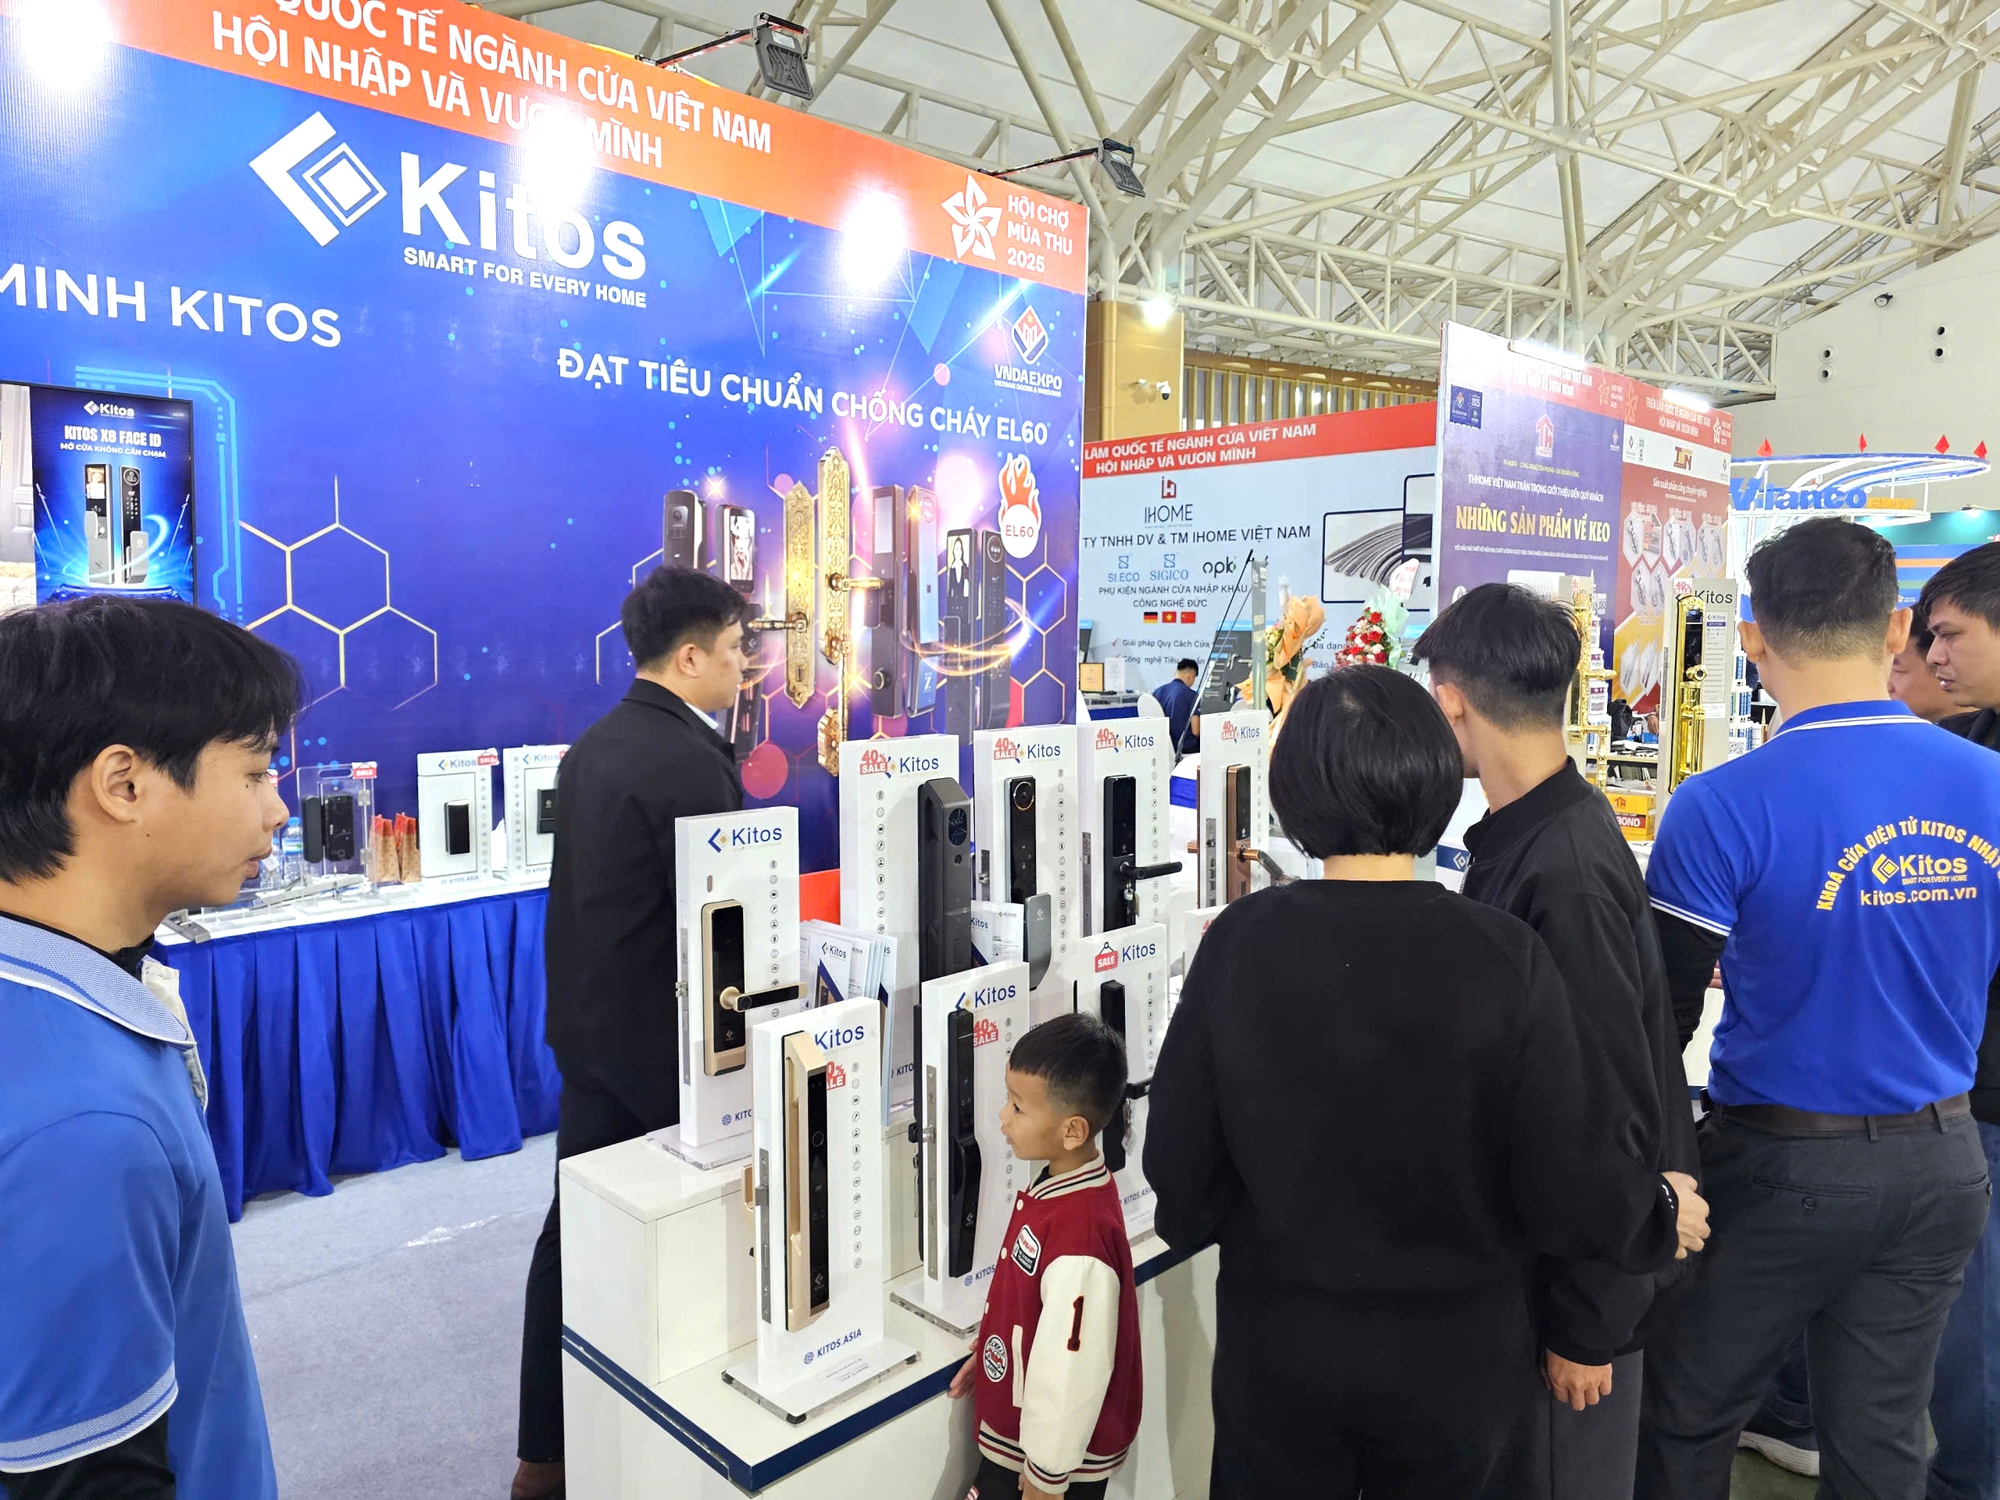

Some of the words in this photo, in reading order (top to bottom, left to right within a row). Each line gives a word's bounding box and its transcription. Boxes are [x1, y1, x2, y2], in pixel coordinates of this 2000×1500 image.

[213, 11, 289, 67] HỘI
[304, 37, 411, 96] NHẬP
[421, 70, 471, 117] VÀ
[585, 116, 662, 168] MÌNH
[396, 9, 443, 54] TẾ
[449, 23, 567, 92] NGÀNH
[577, 64, 638, 114] CỬA
[646, 86, 704, 132] VIỆT
[712, 106, 771, 153] NAM
[400, 151, 647, 281] Kitos
[1008, 194, 1035, 220] HỘI
[1037, 204, 1069, 232] CHỢ
[1007, 220, 1041, 247] MÙA
[1043, 232, 1073, 256] THU
[1007, 247, 1045, 273] 2025
[403, 246, 477, 276] SMART
[483, 263, 523, 285] FOR
[529, 271, 590, 297] EVERY
[595, 284, 647, 308] HOME
[170, 286, 342, 348] KITOS
[994, 363, 1062, 391] VNDAEXPO
[557, 348, 630, 390] ĐẠT
[638, 358, 711, 397] TIÊU
[720, 371, 823, 415] CHUẨN
[831, 387, 923, 428] CHỐNG
[930, 405, 991, 437] CHÁY
[997, 416, 1048, 445] EL60
[100, 403, 135, 417] Kitos
[64, 425, 98, 442] KITOS
[119, 430, 147, 446] FACE
[149, 433, 162, 448] ID
[1111, 440, 1147, 457] QUỐC
[1150, 437, 1166, 453] TẾ
[1167, 433, 1213, 451] NGÀNH
[1249, 426, 1279, 443] VIỆT
[1283, 423, 1316, 439] NAM
[1096, 459, 1117, 475] HỘI
[1120, 456, 1154, 473] NHẬP
[1157, 453, 1175, 468] VÀ
[1220, 445, 1256, 463] MÌNH
[1144, 503, 1194, 524] IHOME
[1455, 502, 1507, 533] NHỮNG
[1510, 505, 1536, 536] SẢN
[1538, 508, 1572, 540] PHẨM
[1588, 520, 1611, 543] KEO
[1005, 524, 1034, 538] EL60
[1083, 537, 1097, 548] TY
[1101, 535, 1133, 547] TNHH
[1137, 533, 1154, 546] DV
[1157, 533, 1166, 545] &
[1170, 531, 1188, 544] TM
[1192, 529, 1236, 543] IHOME
[1241, 525, 1273, 543] VIỆT
[1277, 525, 1311, 539] NAM
[1149, 569, 1189, 581] SIGICO
[1133, 599, 1156, 608] CÔNG
[1694, 590, 1733, 604] Kitos
[995, 737, 1016, 751] 40%
[1097, 739, 1115, 749] SALE
[1125, 735, 1155, 749] Kitos
[1241, 727, 1260, 740] Kitos
[861, 749, 887, 764] 40%
[995, 749, 1016, 760] SALE
[1027, 743, 1061, 759] Kitos
[450, 757, 477, 769] Kitos
[861, 762, 886, 774] SALE
[900, 757, 939, 773] Kitos
[732, 826, 783, 847] Kitos
[1816, 870, 1847, 911] KHOÁ
[1838, 843, 1869, 872] CỬA
[1864, 824, 1898, 850] ĐIỆN
[1921, 820, 1967, 844] KITOS
[1899, 854, 1968, 877] Kitos
[1860, 886, 1977, 907] kitos.com.vn
[829, 944, 847, 959] Kitos
[1097, 955, 1116, 968] SALE
[1122, 943, 1156, 963] Kitos
[975, 984, 1016, 1009] Kitos
[815, 1025, 865, 1050] Kitos
[1066, 1294, 1086, 1353] 1
